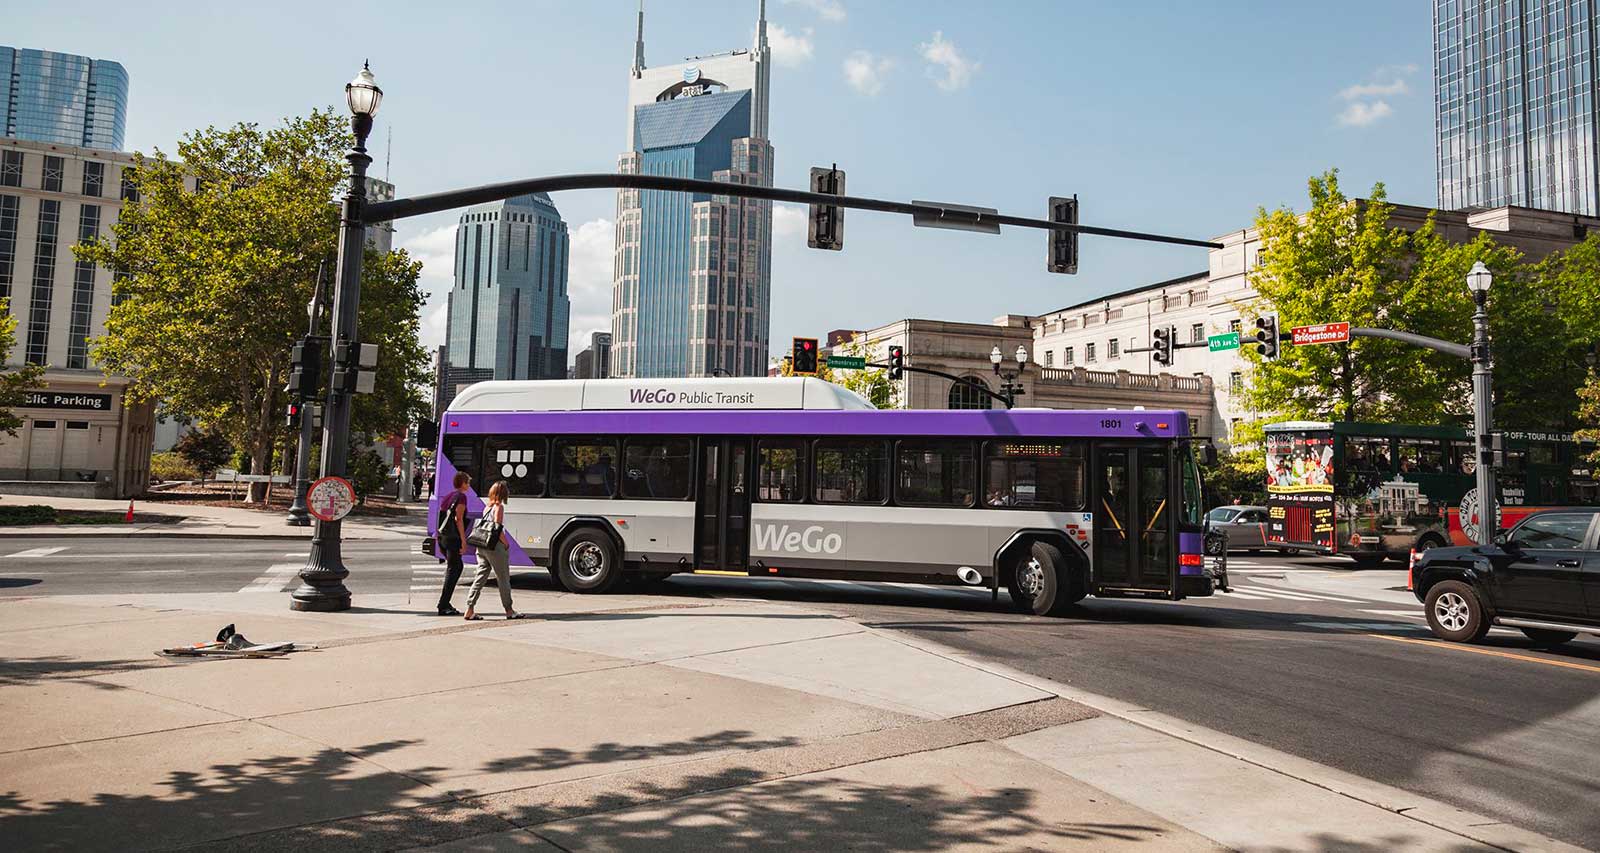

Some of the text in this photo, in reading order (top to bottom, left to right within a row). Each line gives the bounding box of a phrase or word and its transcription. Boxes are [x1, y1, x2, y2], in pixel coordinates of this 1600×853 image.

[1210, 339, 1221, 348] 4th
[1233, 336, 1238, 345] S
[1294, 332, 1337, 342] Bridgestone
[630, 388, 754, 403] WeGo Public Transit
[54, 396, 102, 408] Parking
[1100, 420, 1122, 428] 1801
[1547, 433, 1561, 441] ALL
[754, 524, 842, 554] WeGo
